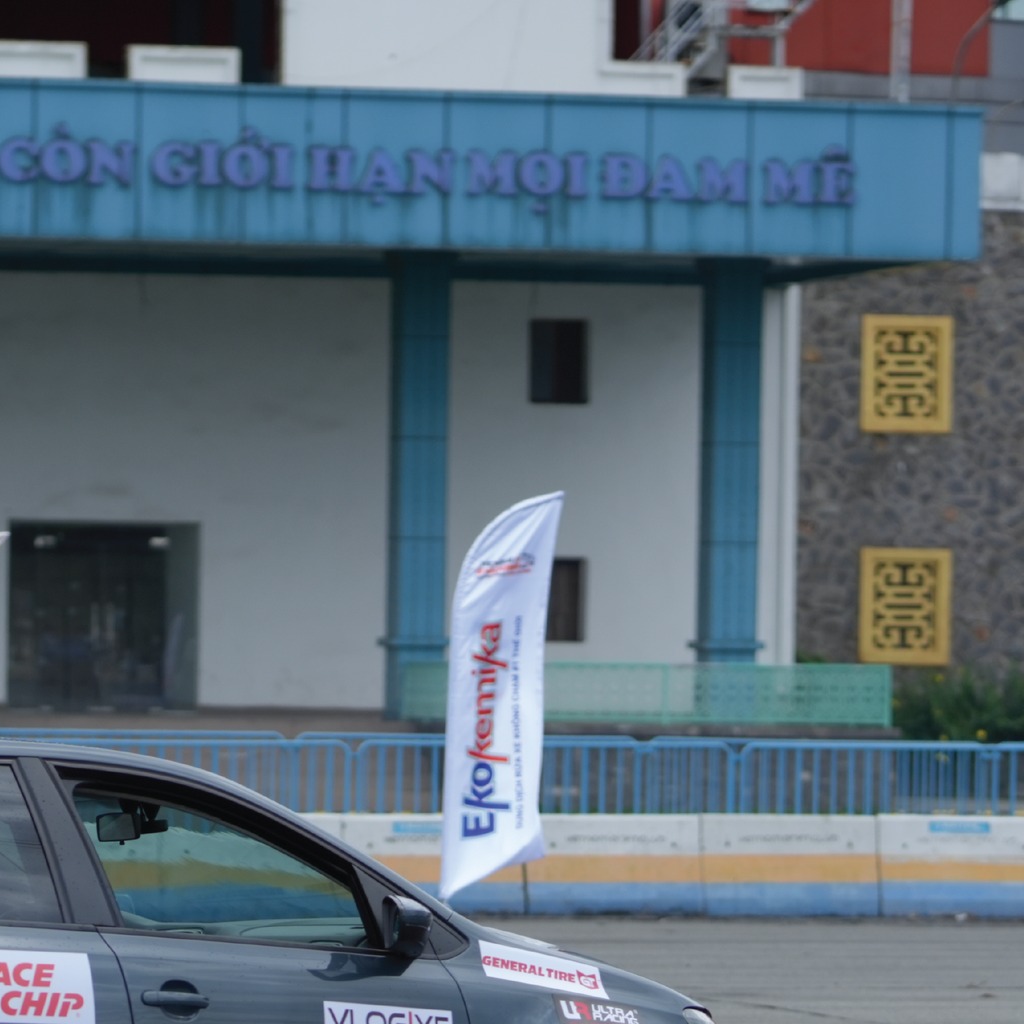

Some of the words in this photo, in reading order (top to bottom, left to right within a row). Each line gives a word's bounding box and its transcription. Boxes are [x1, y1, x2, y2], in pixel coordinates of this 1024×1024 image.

[482, 955, 545, 977] GENERAL
[545, 968, 576, 983] TIRE
[0, 990, 84, 1018] CHIP
[591, 1003, 635, 1018] ULTRA
